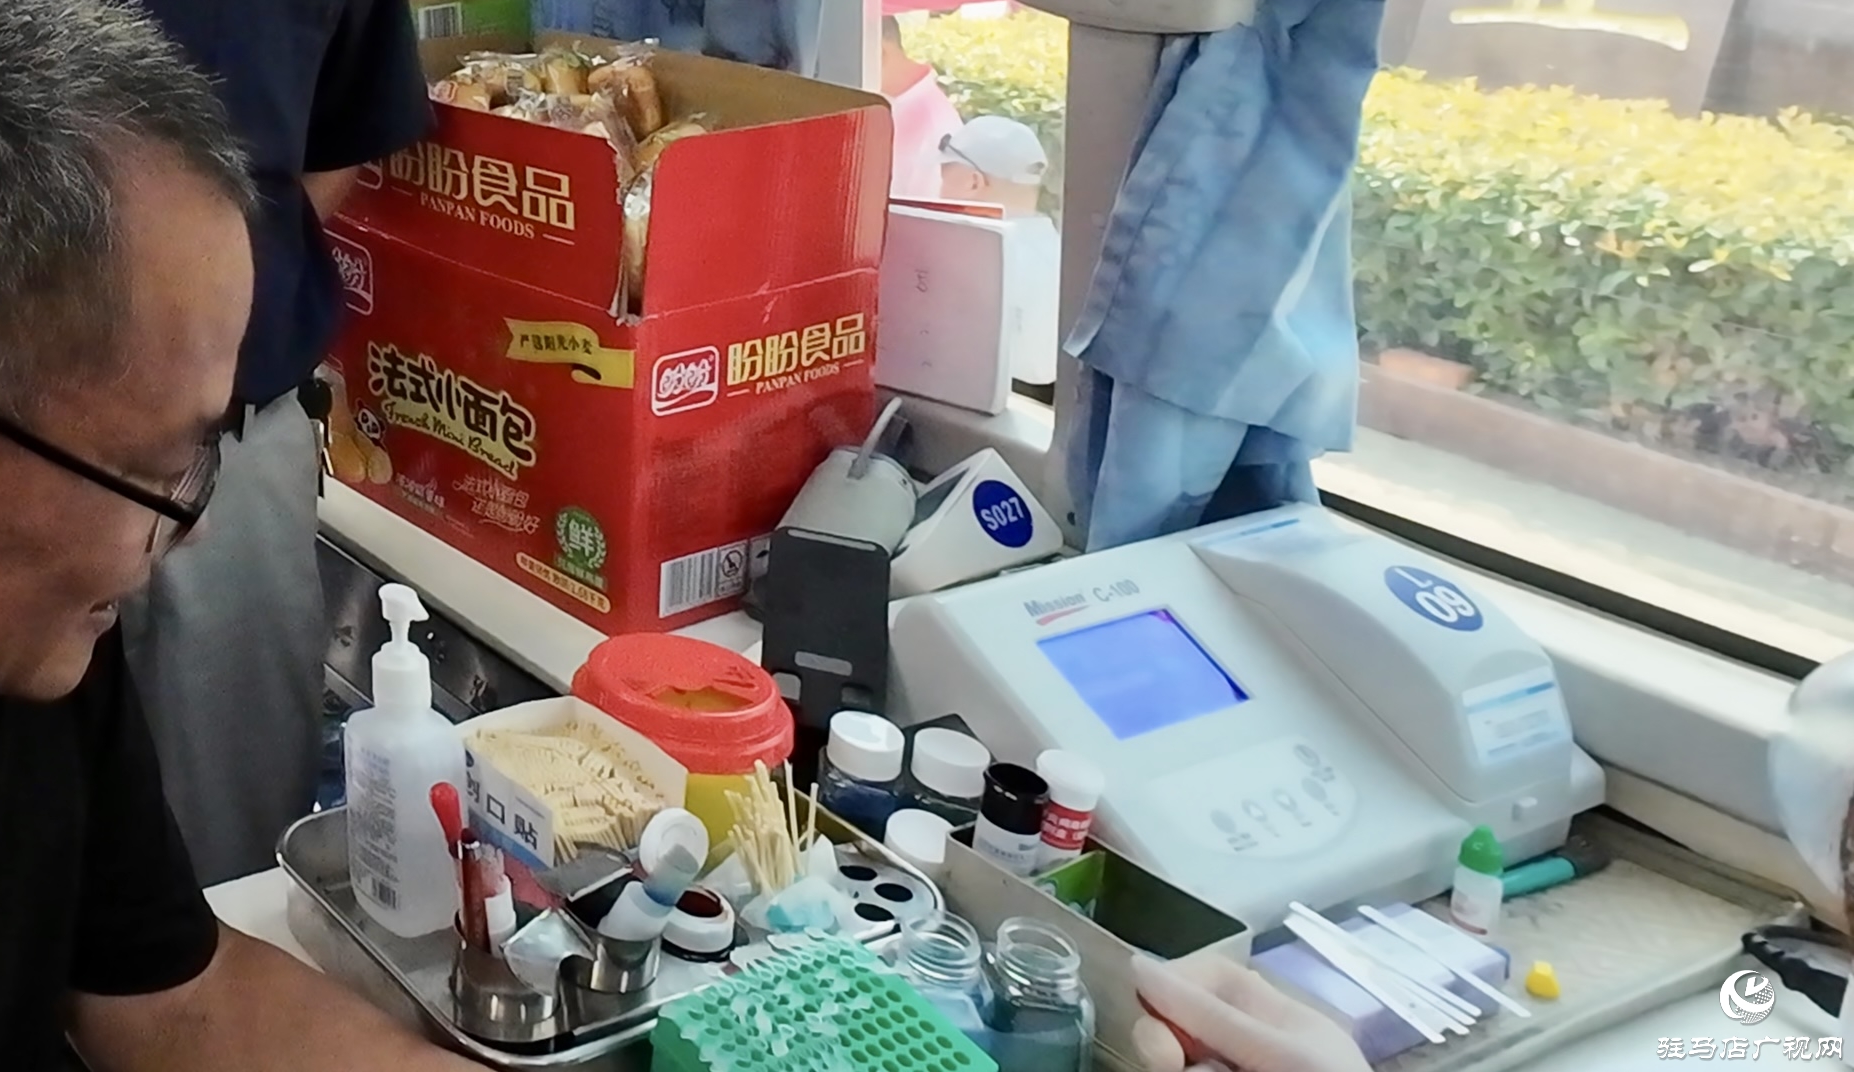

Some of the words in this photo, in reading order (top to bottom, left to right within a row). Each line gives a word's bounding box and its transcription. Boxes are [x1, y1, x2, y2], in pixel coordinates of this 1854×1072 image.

[389, 141, 576, 230] 盼盼食品
[419, 191, 476, 223] PANPAN
[479, 212, 535, 239] FOODS
[727, 312, 866, 386] 盼盼食品
[755, 371, 802, 395] PANPAN
[804, 362, 840, 382] FOODS
[368, 342, 536, 466] 法式小面包
[433, 417, 464, 446] Mini
[468, 436, 517, 475] Bread
[569, 519, 595, 556] 鲜
[980, 496, 1025, 531] S027
[1023, 592, 1087, 617] Mission
[1092, 579, 1140, 602] C-100
[1415, 585, 1475, 623] 09
[467, 771, 539, 850] 创口贴
